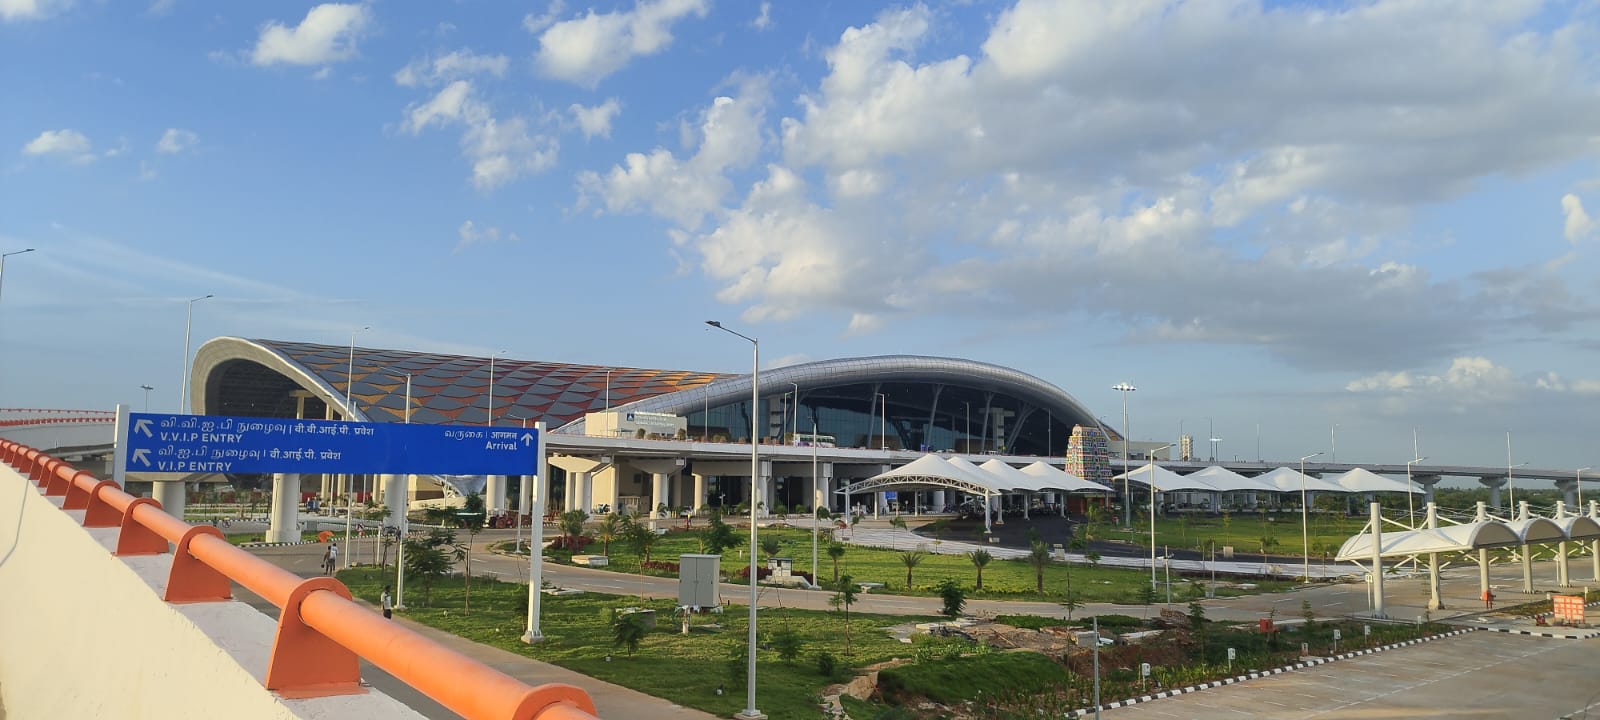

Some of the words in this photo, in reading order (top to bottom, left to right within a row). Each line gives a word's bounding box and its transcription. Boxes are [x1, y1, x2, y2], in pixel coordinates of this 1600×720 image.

[354, 425, 374, 436] प्रवेश
[444, 430, 483, 441] வருகை
[491, 431, 518, 440] आगमन
[160, 432, 199, 442] V.V.I.P
[201, 433, 242, 443] ENTRY
[485, 441, 518, 451] Arrival
[320, 449, 341, 460] प्रवेश
[158, 461, 186, 471] V.I.P
[189, 462, 232, 472] ENTRY
